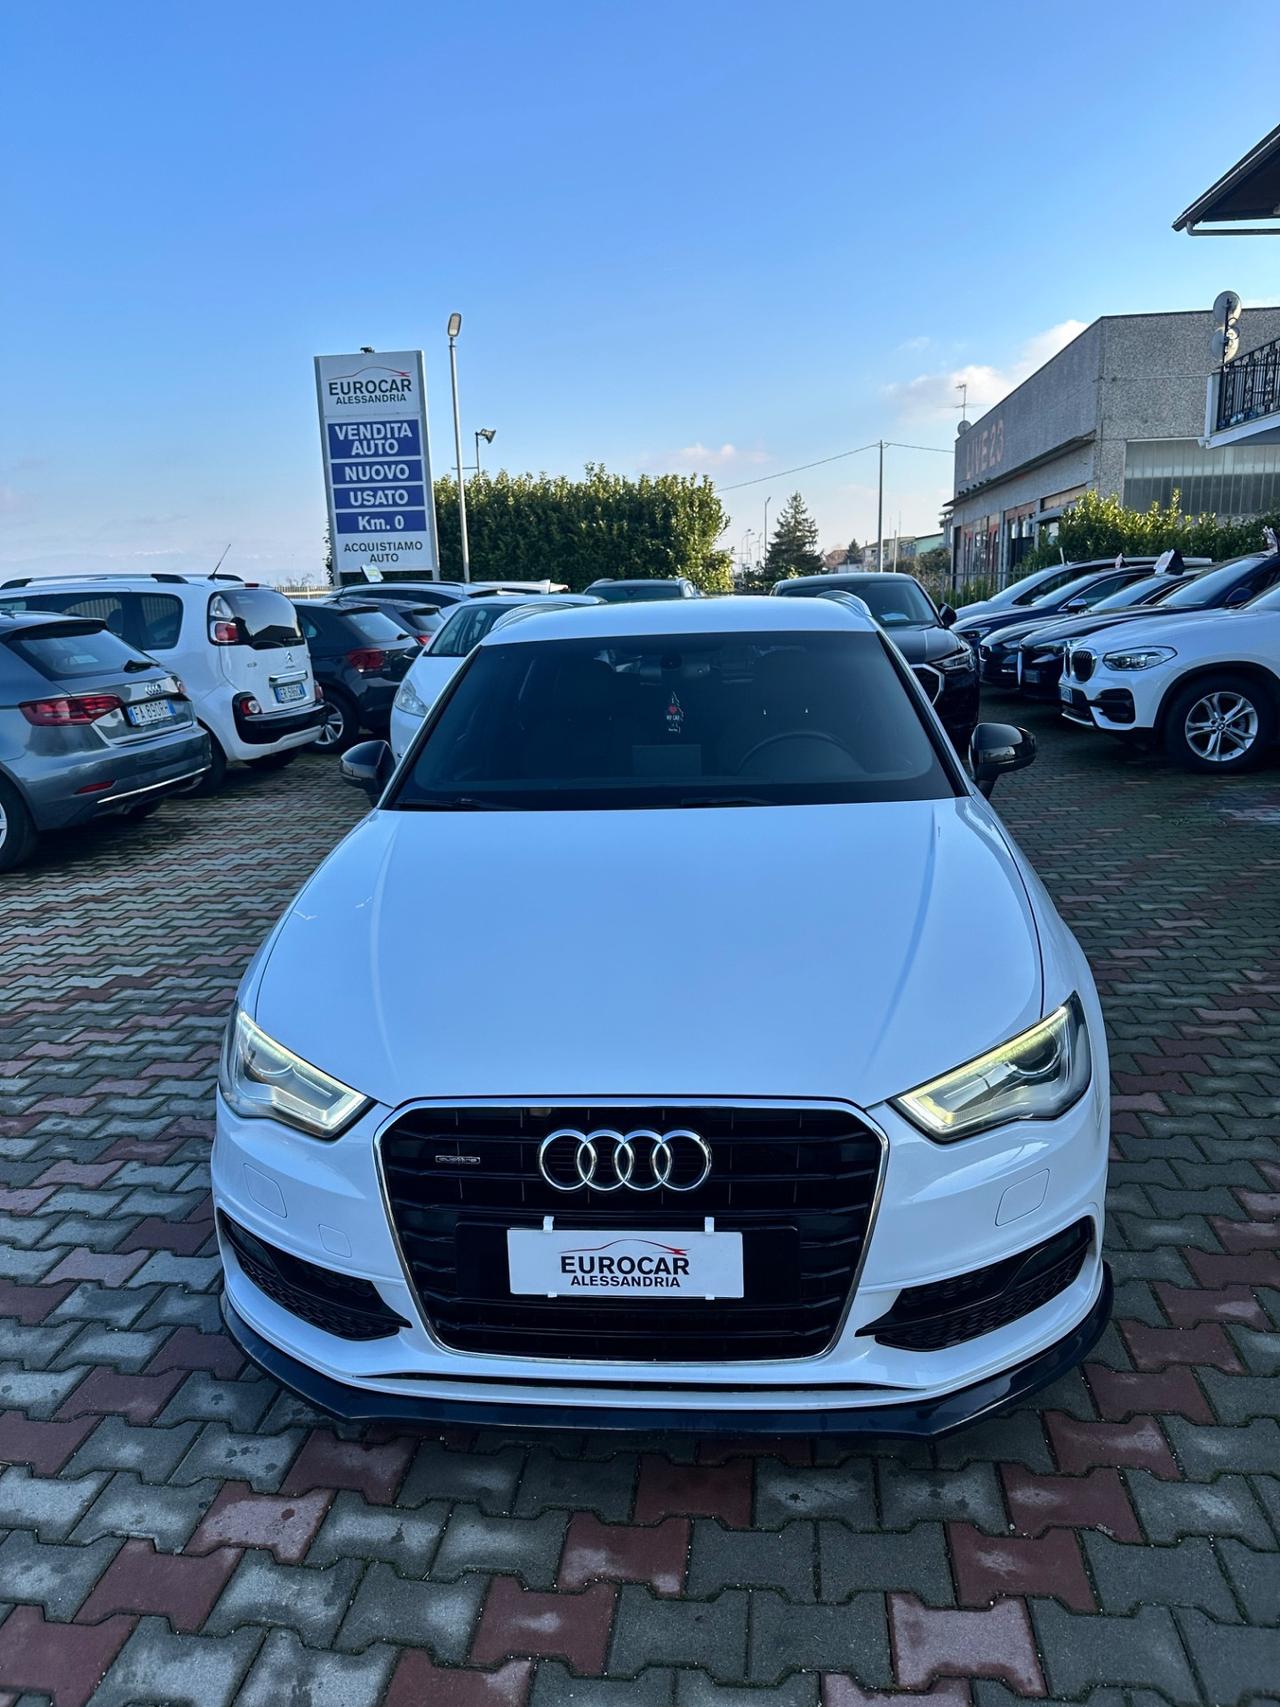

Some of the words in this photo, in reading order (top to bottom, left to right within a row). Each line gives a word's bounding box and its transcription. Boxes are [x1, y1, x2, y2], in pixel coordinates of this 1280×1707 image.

[329, 379, 412, 396] EUROCAR
[336, 394, 407, 405] ALESSANDRIA
[335, 423, 412, 441] VENDITA
[351, 439, 399, 456] AUTO
[345, 464, 409, 481] NUOVO
[350, 489, 408, 506] USATO
[358, 516, 390, 531] Km.
[394, 515, 404, 530] 0
[344, 541, 423, 553] ACQUISTIAMO
[369, 553, 399, 563] AUTO
[560, 1256, 690, 1275] EUROCAR
[570, 1275, 681, 1288] ALESSANDRIA
